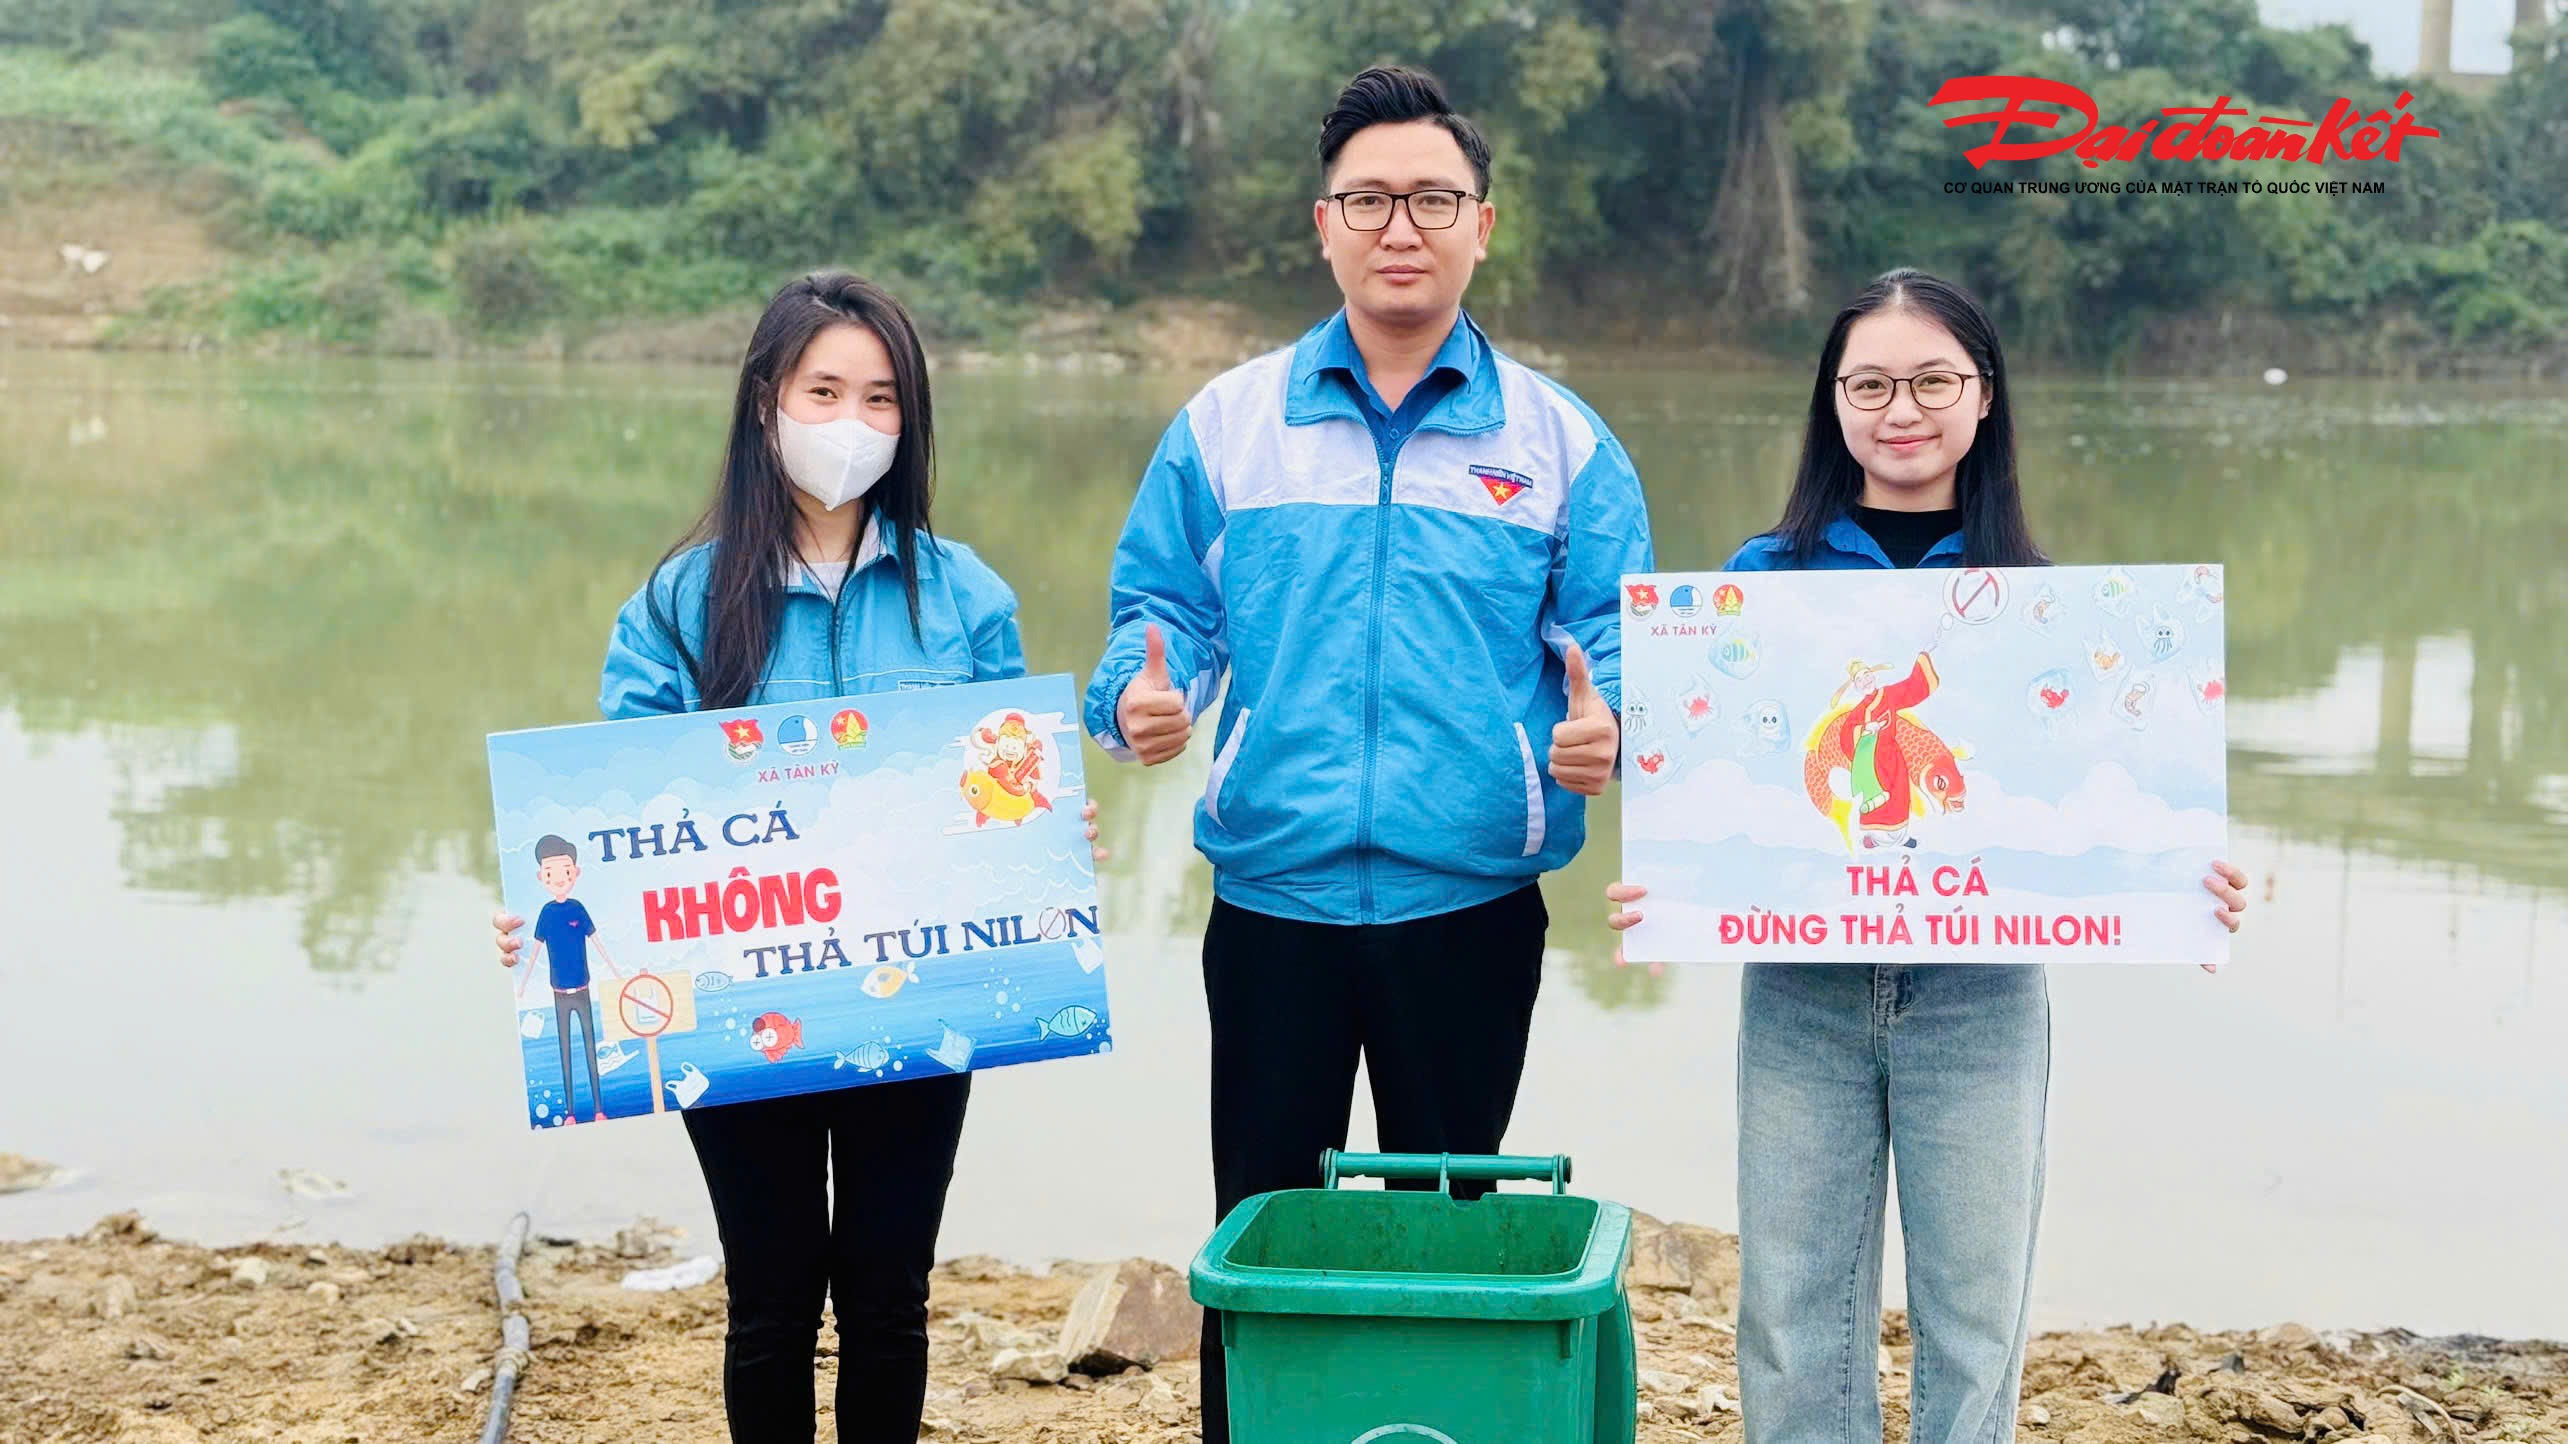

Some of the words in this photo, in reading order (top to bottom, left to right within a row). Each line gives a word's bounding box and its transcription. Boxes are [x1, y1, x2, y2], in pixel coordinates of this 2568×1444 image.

[1672, 624, 1697, 636] TÂN
[784, 764, 816, 780] TÂN
[588, 808, 708, 862] THẢ
[722, 800, 800, 847] CÁ
[1846, 854, 1919, 896] THẢ
[1932, 856, 1989, 896] CÁ
[642, 866, 842, 943] KHÔNG
[1719, 904, 1828, 945] ĐỪNG
[1840, 903, 1914, 945] THẢ
[1925, 905, 1979, 945] TÚI
[1994, 914, 2121, 945] NILON!
[743, 927, 852, 978] THẢ
[864, 919, 950, 962] TÚI
